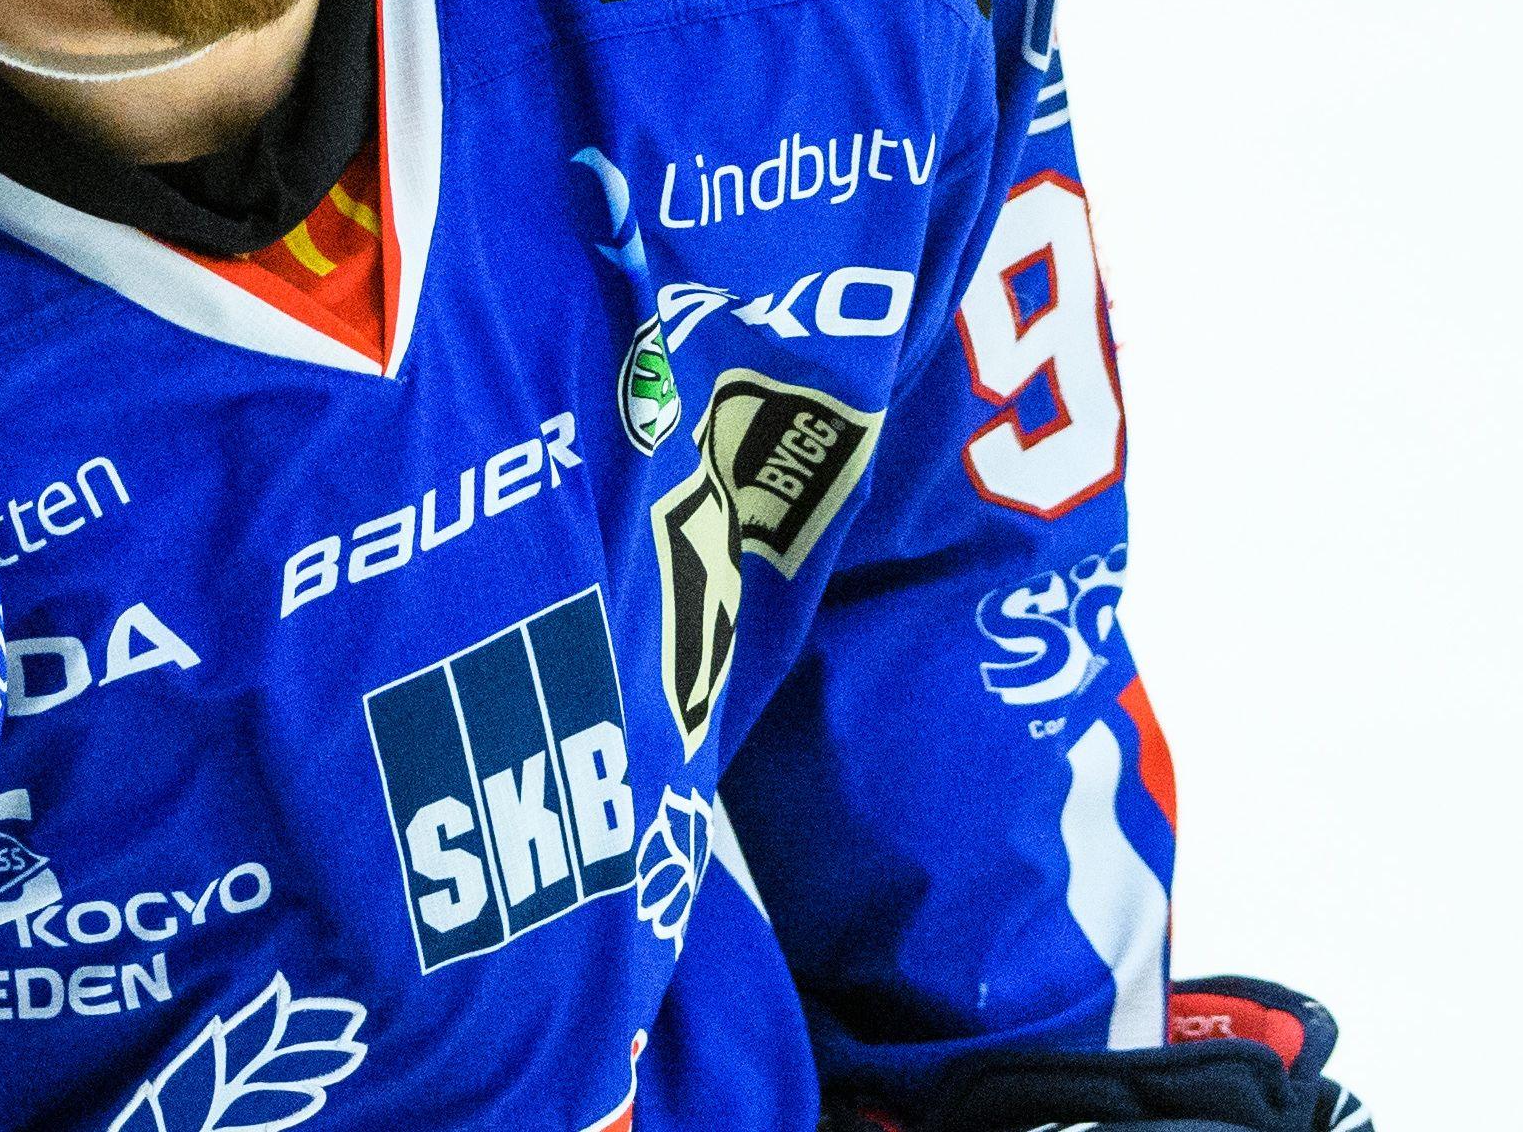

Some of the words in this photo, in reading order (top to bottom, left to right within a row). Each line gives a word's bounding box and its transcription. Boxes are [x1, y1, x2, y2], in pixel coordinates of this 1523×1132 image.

[280, 411, 582, 619] BAUER
[756, 411, 839, 502] BYGG
[405, 720, 636, 933] SKB
[15, 861, 272, 949] KOGYO
